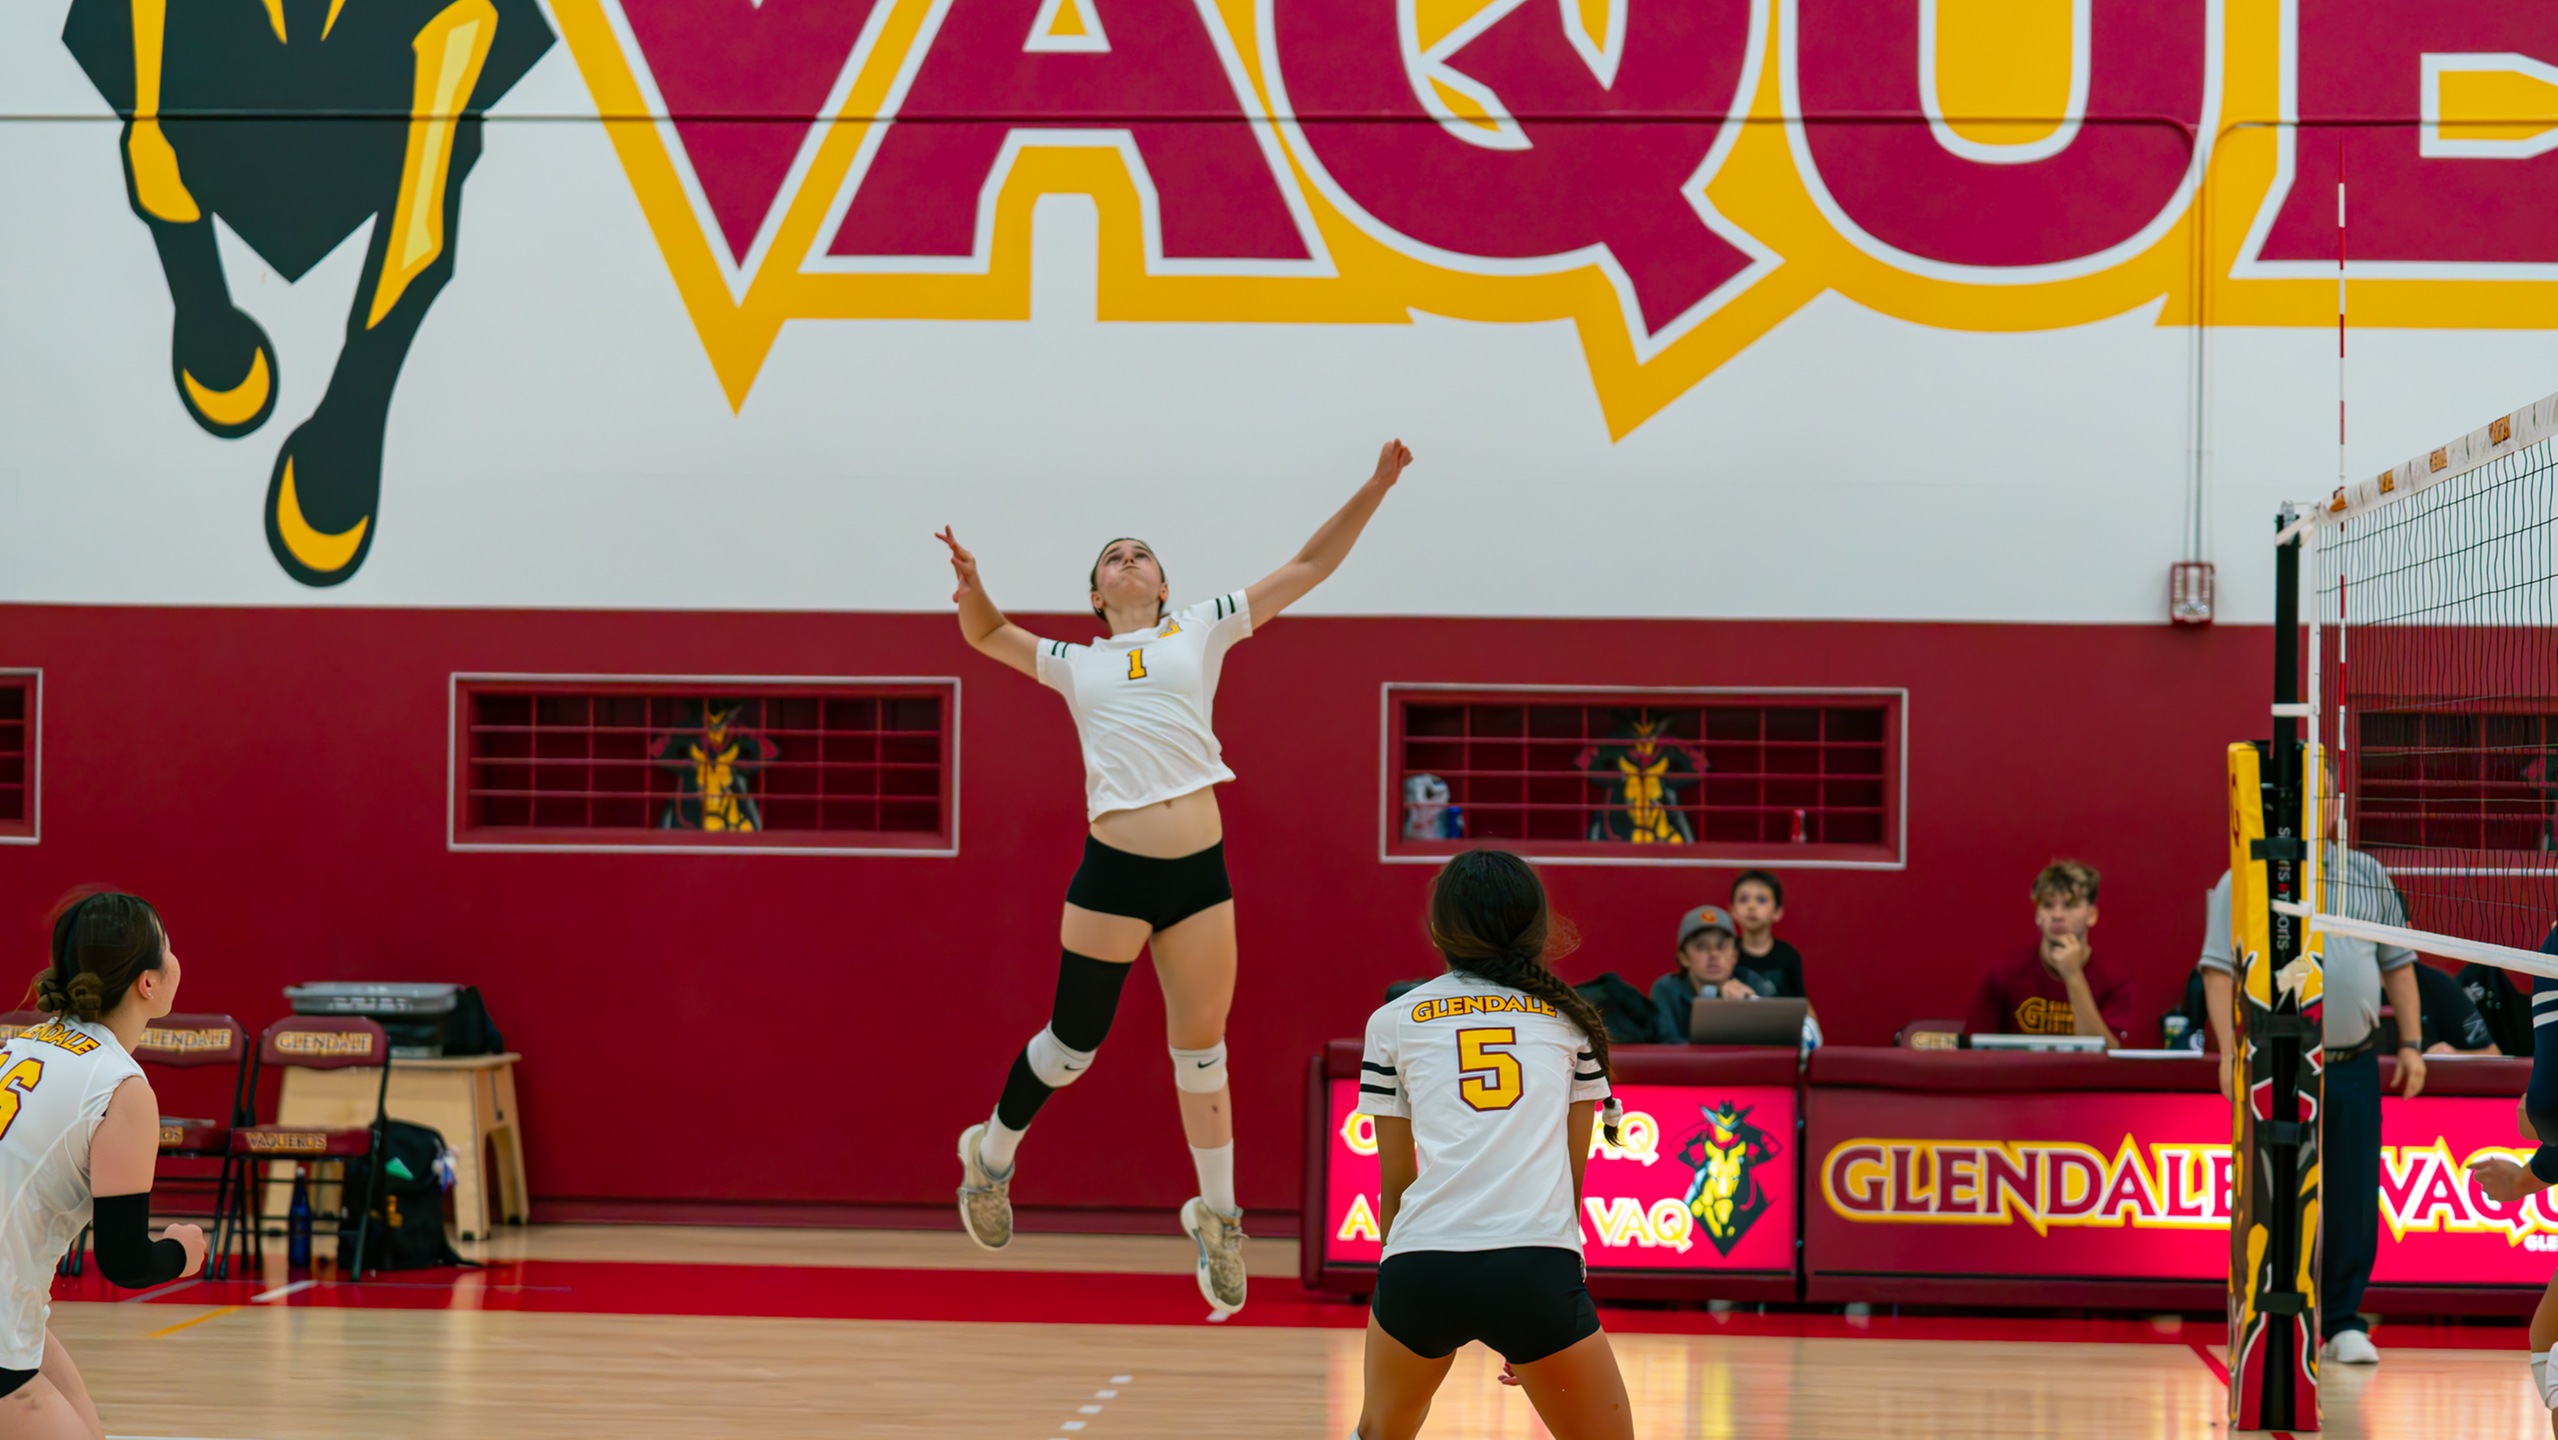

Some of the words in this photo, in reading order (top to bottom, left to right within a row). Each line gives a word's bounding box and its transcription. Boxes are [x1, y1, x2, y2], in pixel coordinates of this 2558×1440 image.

[1127, 647, 1147, 680] 1
[1411, 995, 1557, 1023] GLENDALE
[275, 1031, 373, 1055] GLENDALE
[1456, 1027, 1524, 1112] 5
[246, 1132, 327, 1154] VAQUEROS
[1822, 1134, 2232, 1237] GLENDALE
[1583, 1197, 1694, 1253] VAQ
